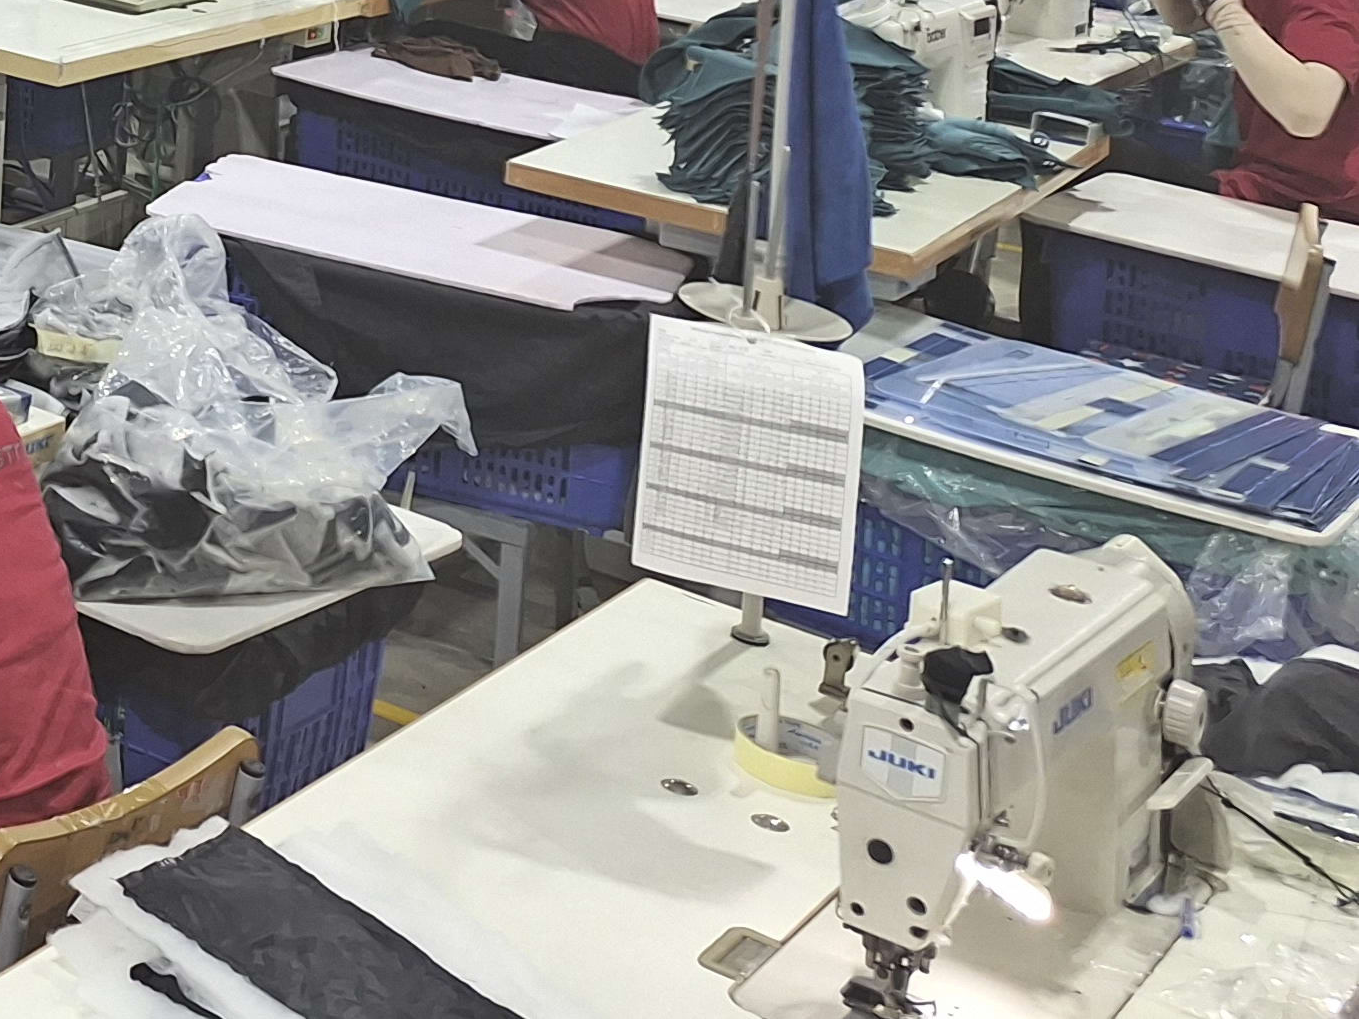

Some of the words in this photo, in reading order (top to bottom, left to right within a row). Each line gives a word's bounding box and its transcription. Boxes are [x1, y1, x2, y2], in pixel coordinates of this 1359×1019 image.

[25, 435, 52, 455] UKI
[1053, 686, 1093, 735] JUKI
[867, 749, 938, 780] JUKI
